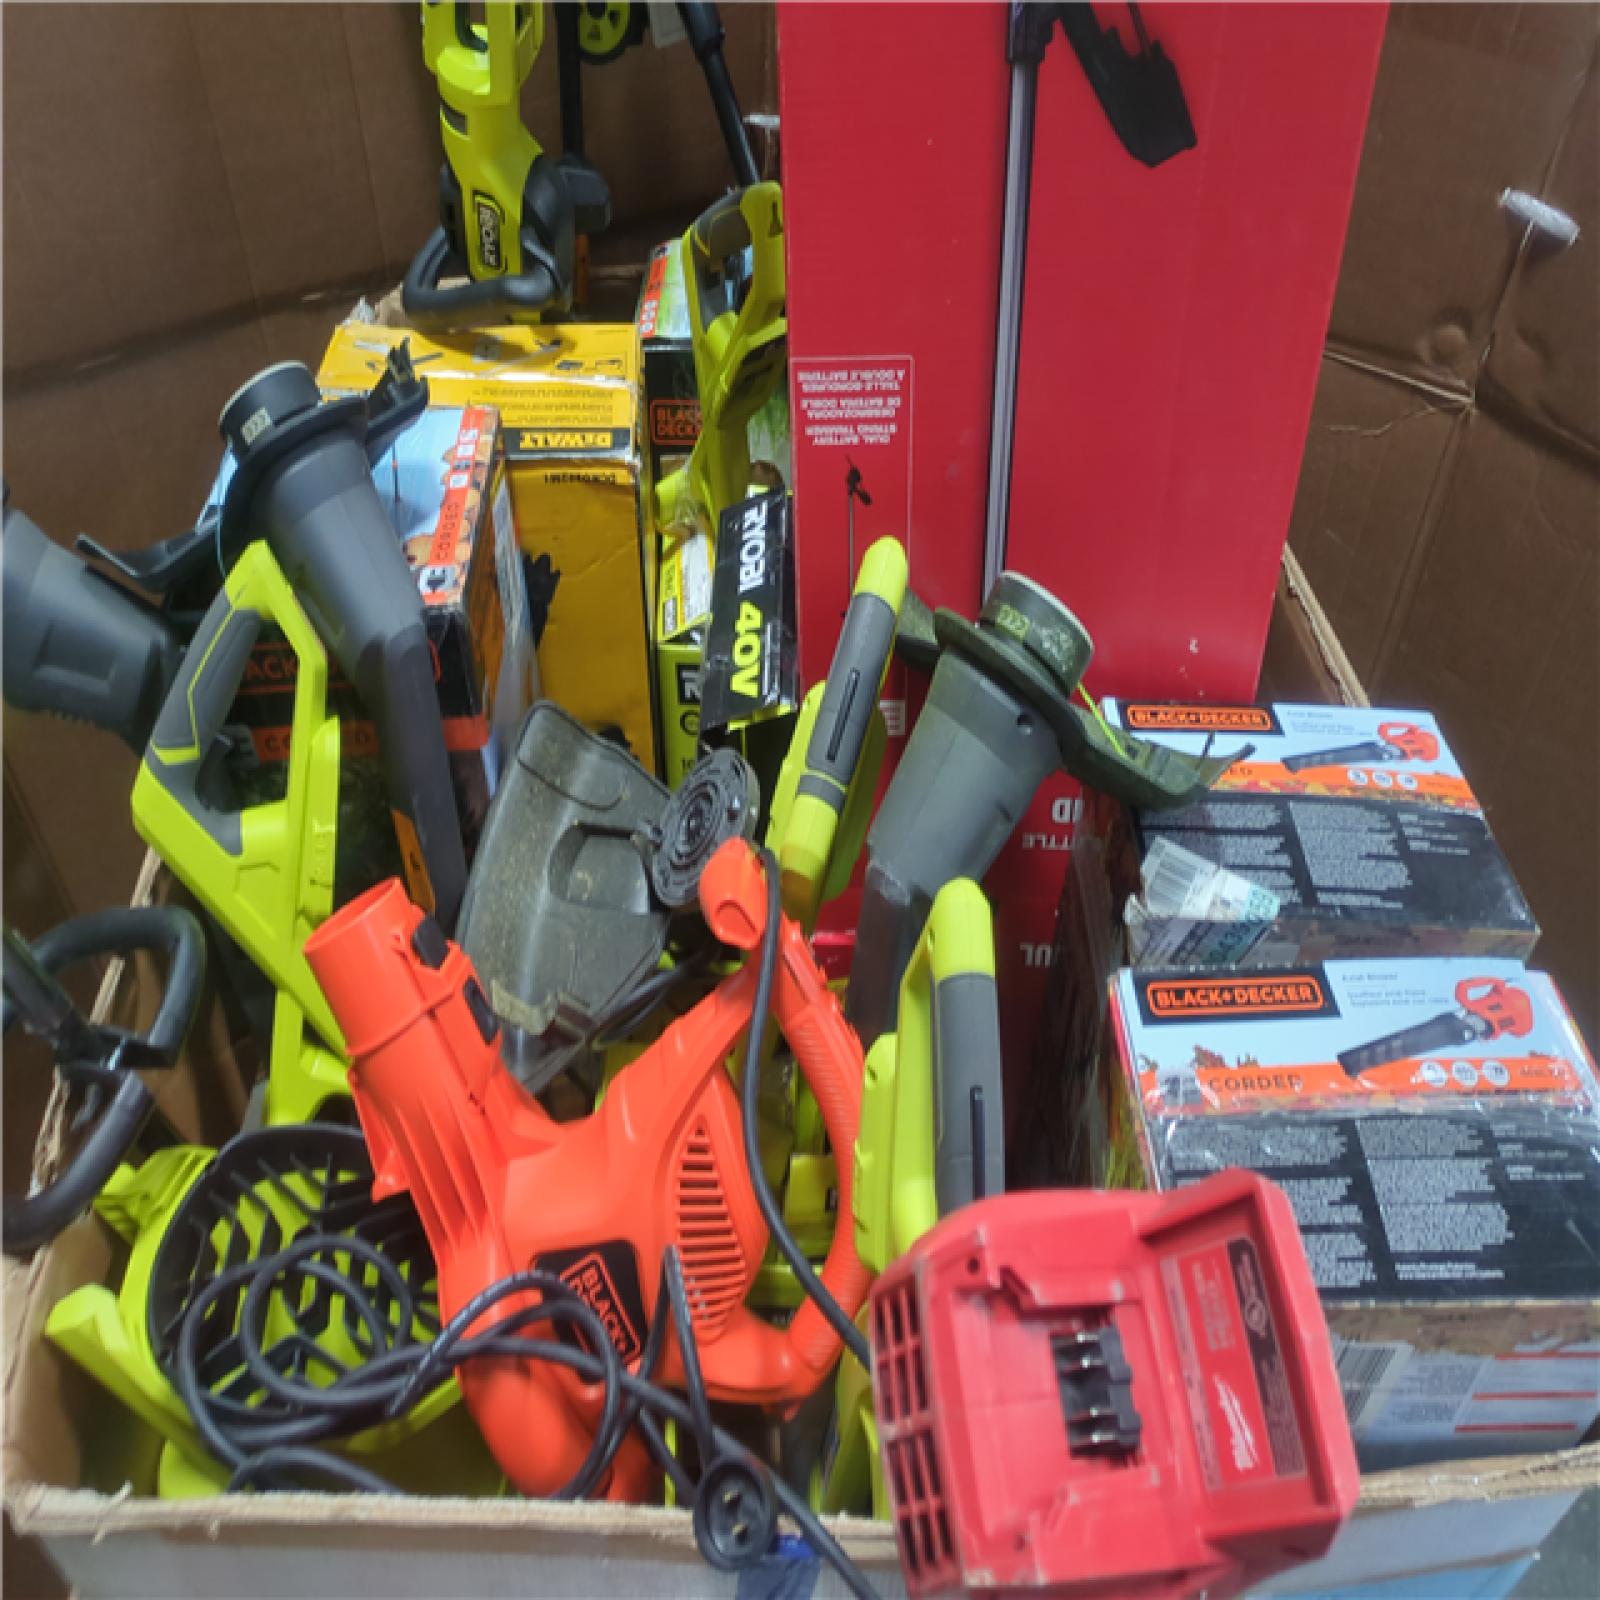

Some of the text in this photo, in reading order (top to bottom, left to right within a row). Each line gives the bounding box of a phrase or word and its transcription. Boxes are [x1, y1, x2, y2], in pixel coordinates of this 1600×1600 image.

[806, 425, 854, 435] TRIMMER
[814, 433, 858, 445] BATTERY
[519, 431, 613, 450] DEWALT
[729, 499, 769, 698] RYOBI 40V
[1156, 983, 1313, 1008] BLACK+DECKER
